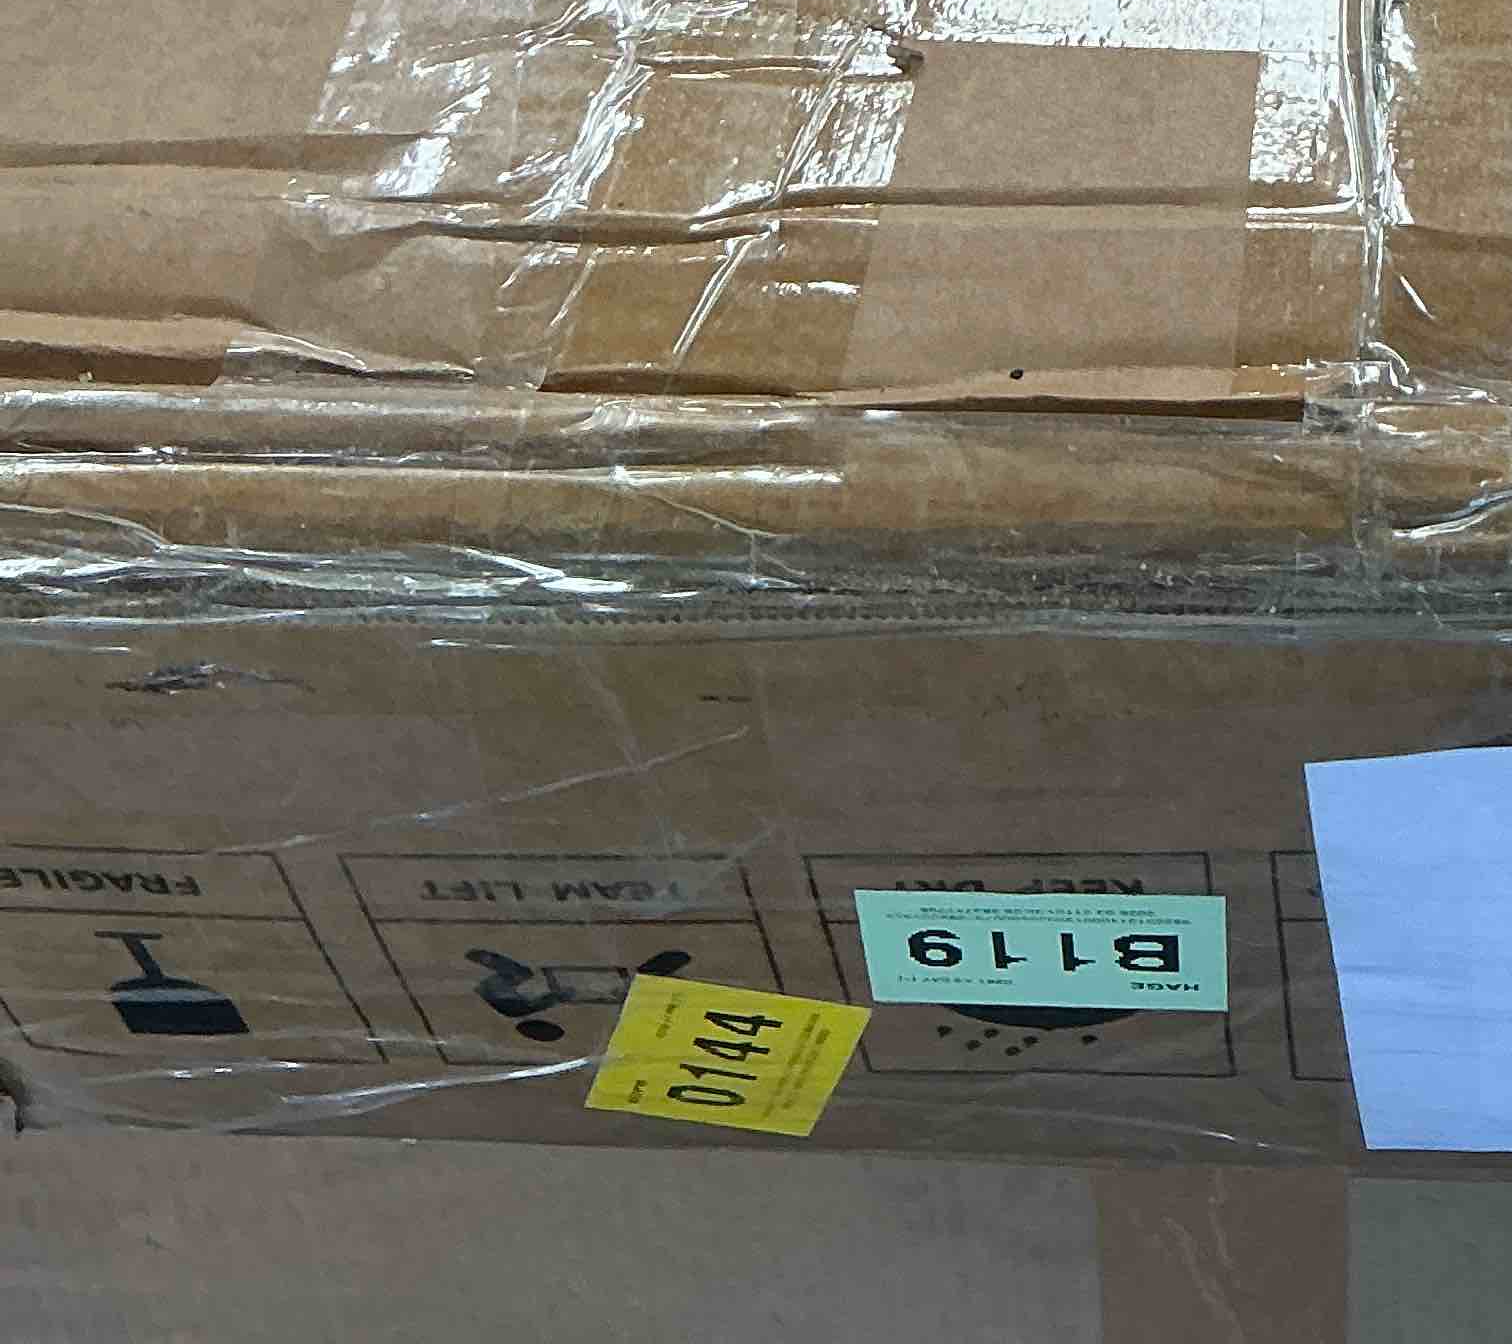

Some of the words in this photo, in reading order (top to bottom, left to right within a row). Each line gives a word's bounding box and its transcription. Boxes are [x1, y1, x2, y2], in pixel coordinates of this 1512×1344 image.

[0, 865, 202, 897] FRAGILE
[421, 878, 525, 902] LIFT
[904, 928, 1181, 975] B119
[1128, 981, 1200, 992] HAGE
[666, 1009, 783, 1109] 0144
